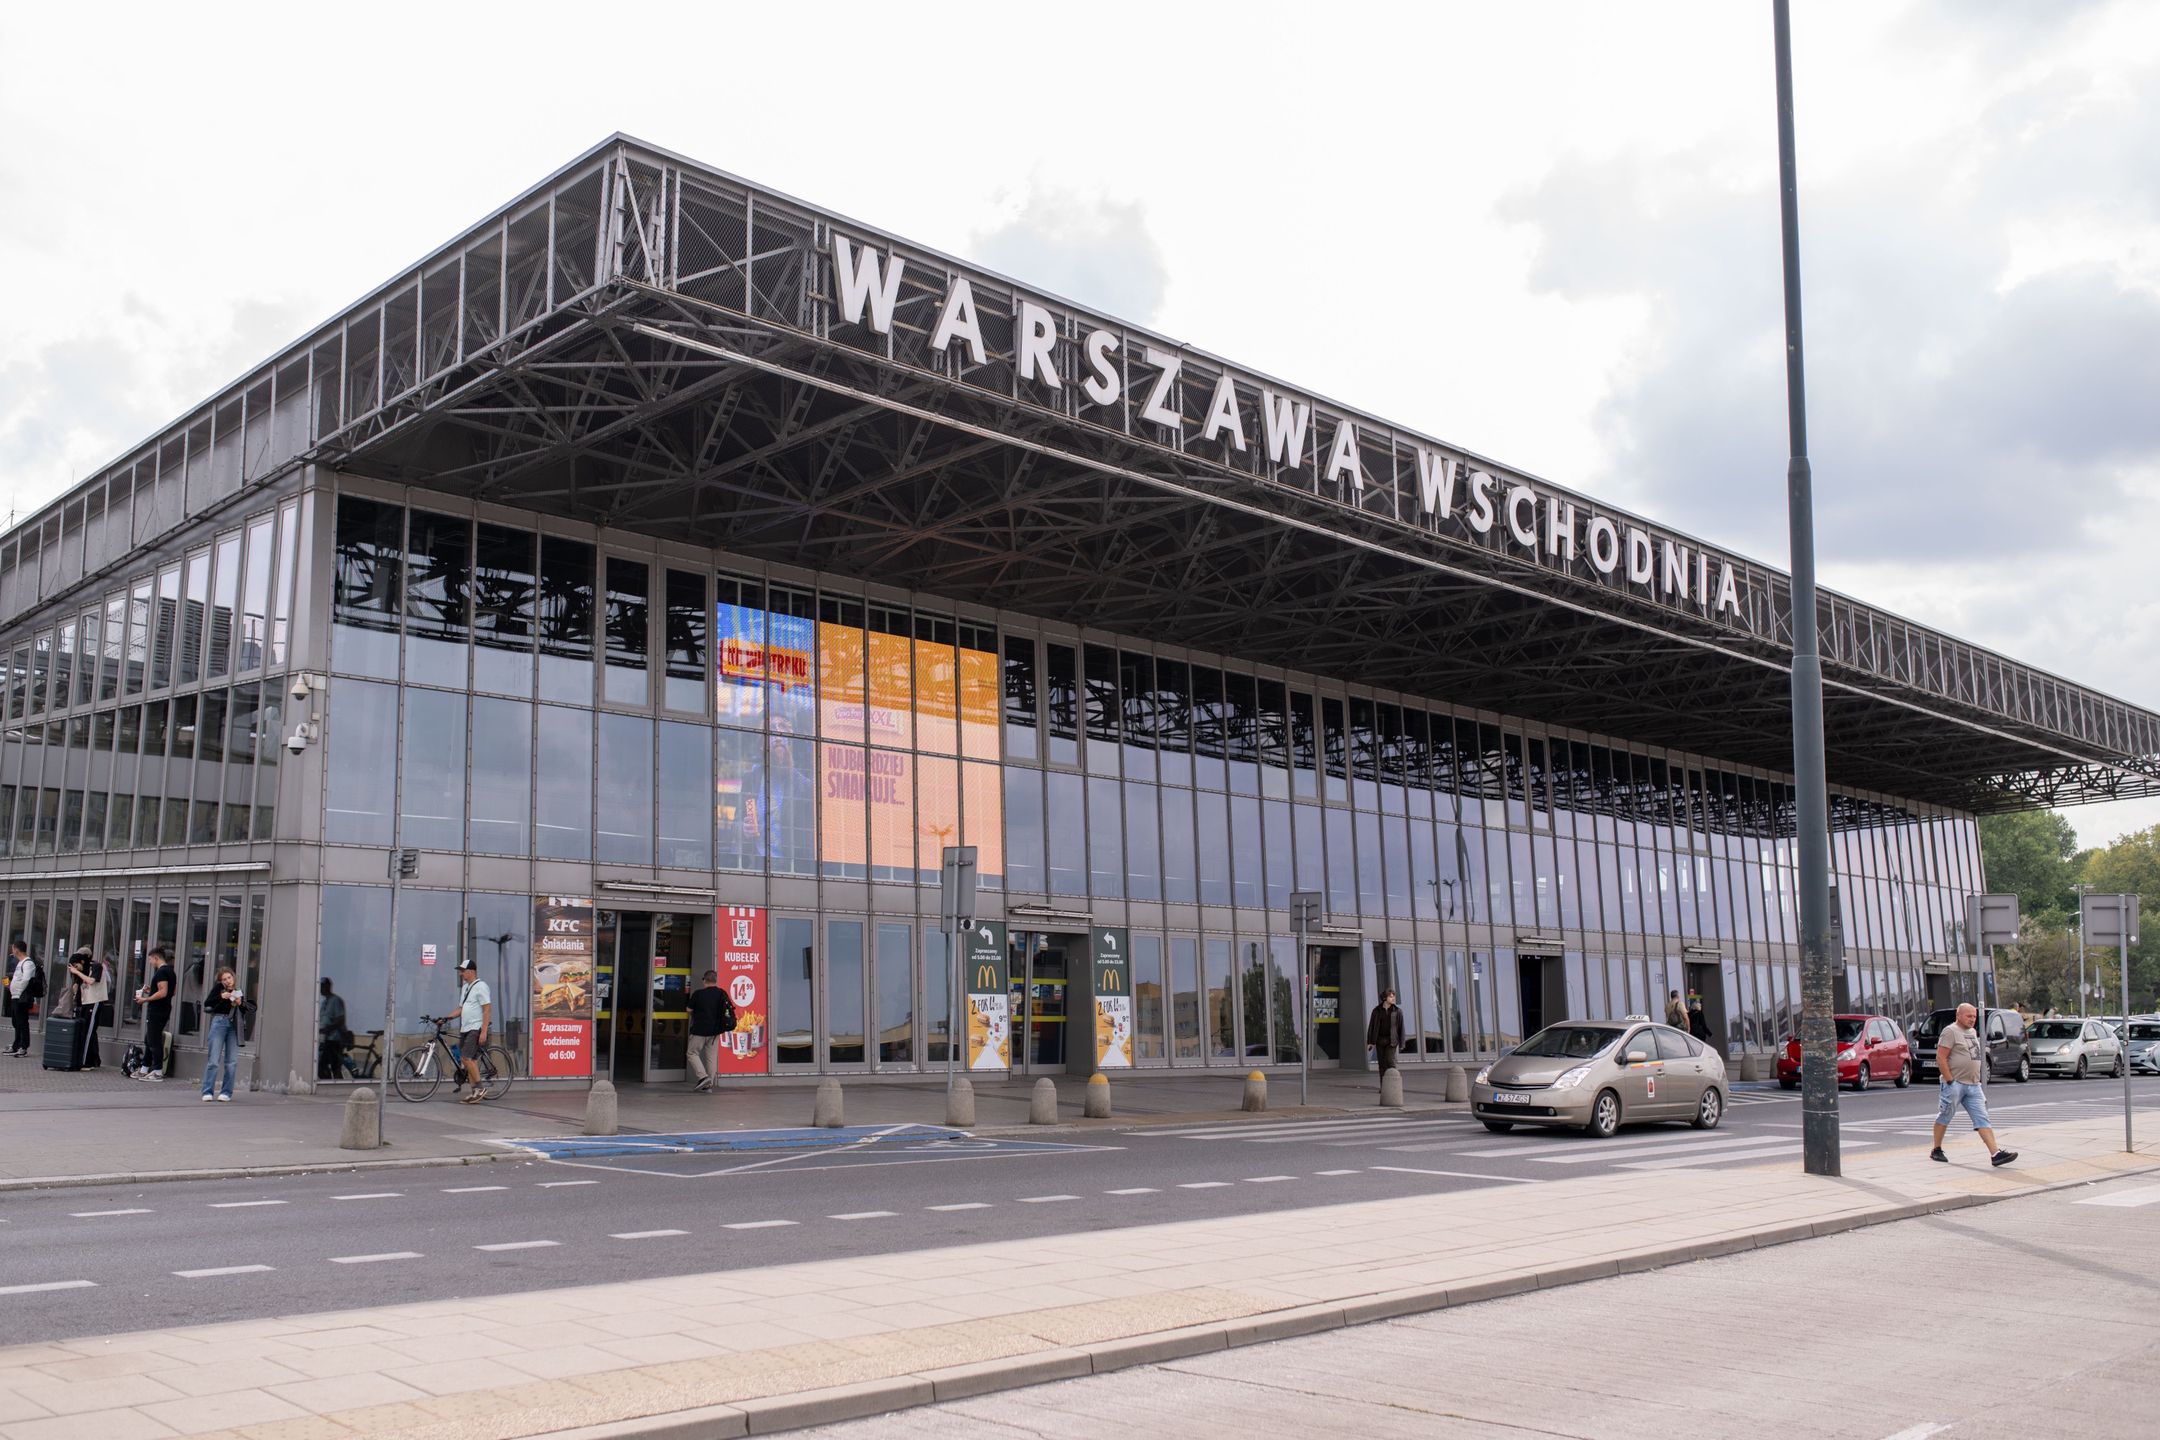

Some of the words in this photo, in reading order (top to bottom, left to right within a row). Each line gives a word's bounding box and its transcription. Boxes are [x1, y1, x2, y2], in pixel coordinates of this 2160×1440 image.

[831, 234, 1364, 491] WARSZAWA
[1414, 447, 1741, 617] WSCHODNIA
[547, 919, 580, 932] KFC
[542, 936, 585, 951] Śniadania
[724, 952, 760, 963] KUBEŁEK
[541, 1023, 582, 1034] Zapraszamy
[543, 1037, 580, 1046] codziennie
[549, 1050, 558, 1060] od
[559, 1051, 576, 1060] 6:00
